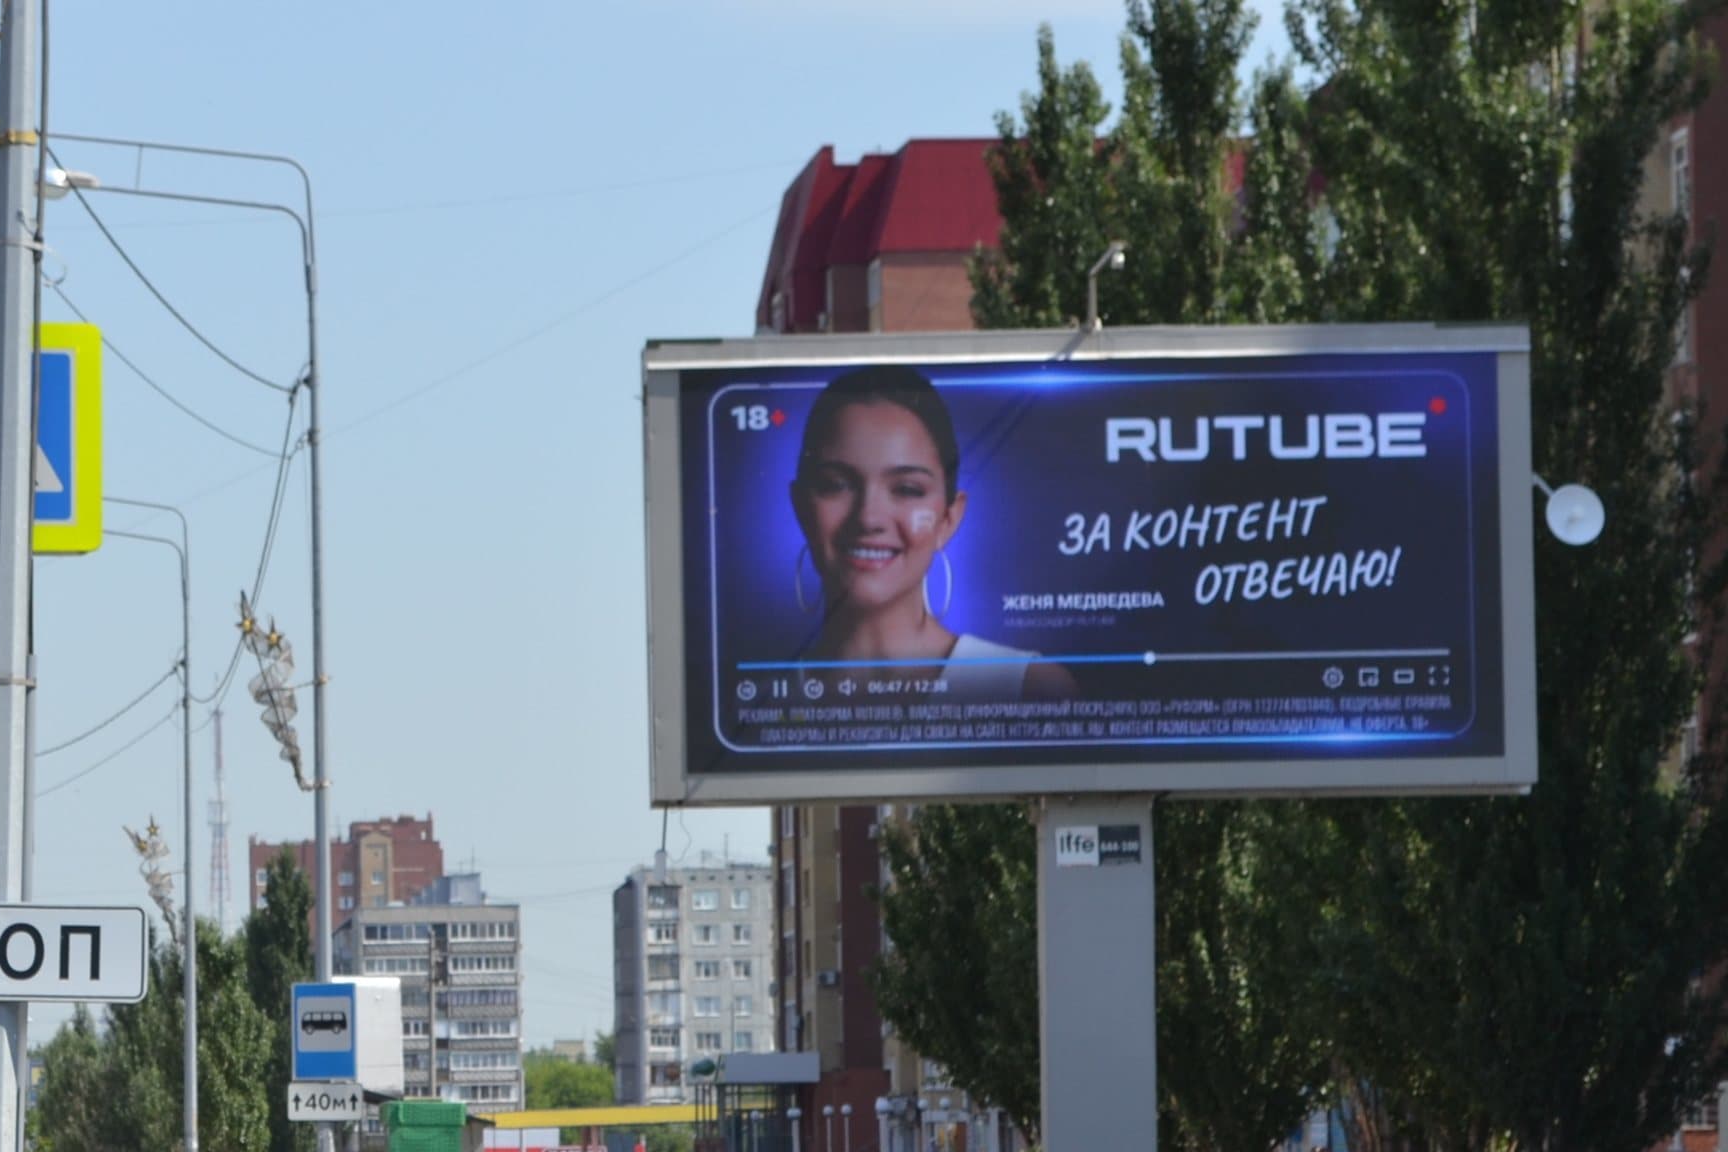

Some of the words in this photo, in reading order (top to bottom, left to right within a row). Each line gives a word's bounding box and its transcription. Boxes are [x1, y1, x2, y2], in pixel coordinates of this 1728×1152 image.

[1105, 412, 1427, 463] RUTUBE
[1059, 512, 1111, 556] ЗА
[1123, 496, 1329, 552] КОНТЕНТ
[1003, 594, 1054, 611] ЖЕНЯ
[1057, 591, 1165, 610] МЕДВЕДЕВА
[1195, 546, 1402, 606] ОТВЕЧАЮ!
